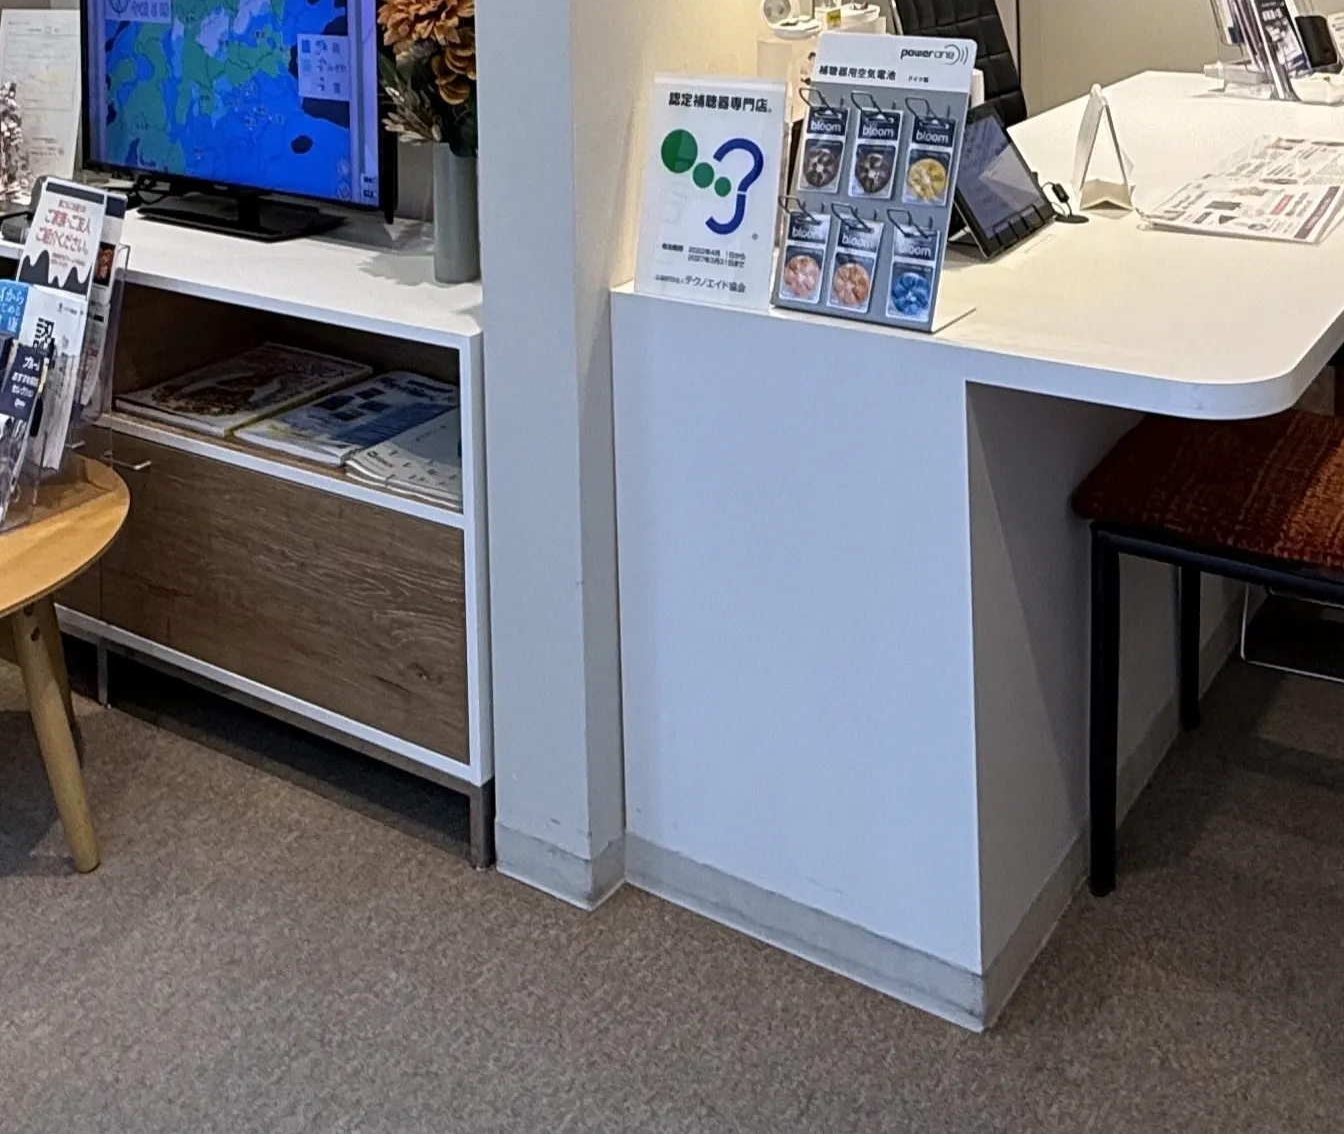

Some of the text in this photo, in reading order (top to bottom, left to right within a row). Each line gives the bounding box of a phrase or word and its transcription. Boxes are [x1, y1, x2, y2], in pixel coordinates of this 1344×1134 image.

[818, 64, 897, 81] 補聴器用空気電池
[810, 120, 841, 133] bloom
[862, 124, 895, 138] bloom
[915, 129, 949, 143] bloom
